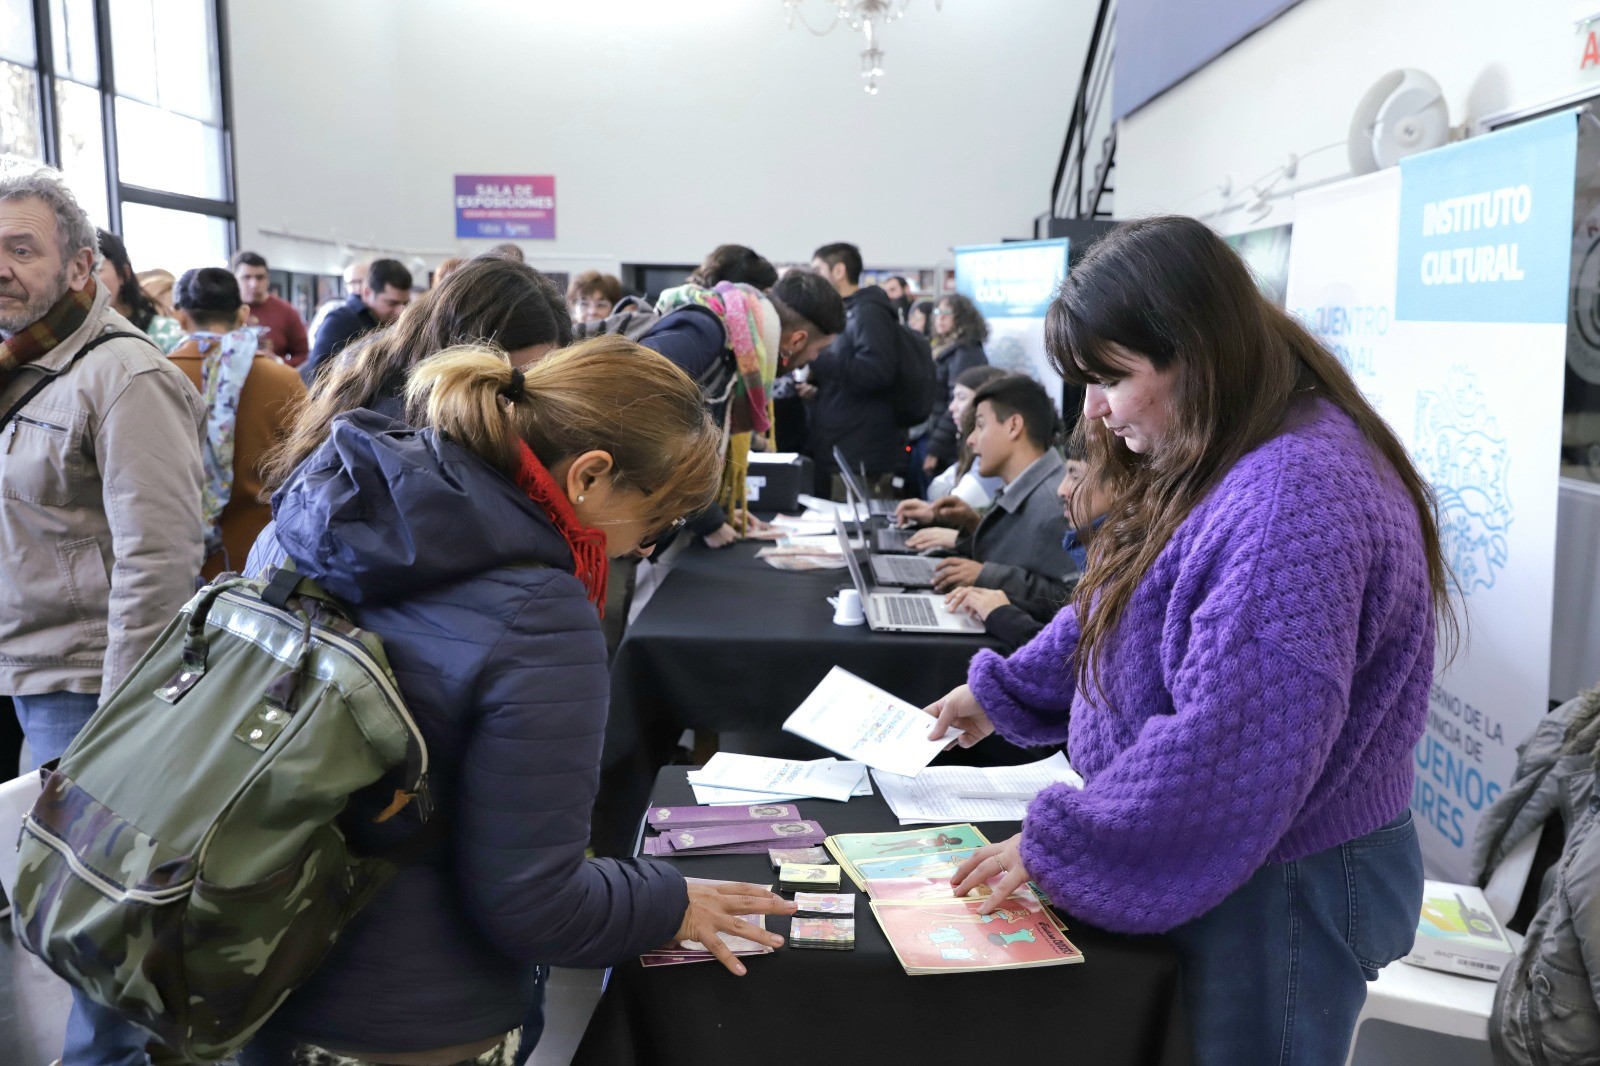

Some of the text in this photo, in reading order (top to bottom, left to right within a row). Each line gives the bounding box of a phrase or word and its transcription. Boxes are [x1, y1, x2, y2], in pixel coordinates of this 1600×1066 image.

[456, 195, 553, 209] EXPOSICIONES
[475, 183, 534, 198] SALA DE
[1422, 184, 1532, 237] INSTITUTO
[1421, 242, 1525, 286] CULTURAL
[1463, 703, 1483, 732] DE
[1485, 714, 1504, 747] LA
[1464, 734, 1484, 764] DE
[1411, 775, 1464, 848] IRES
